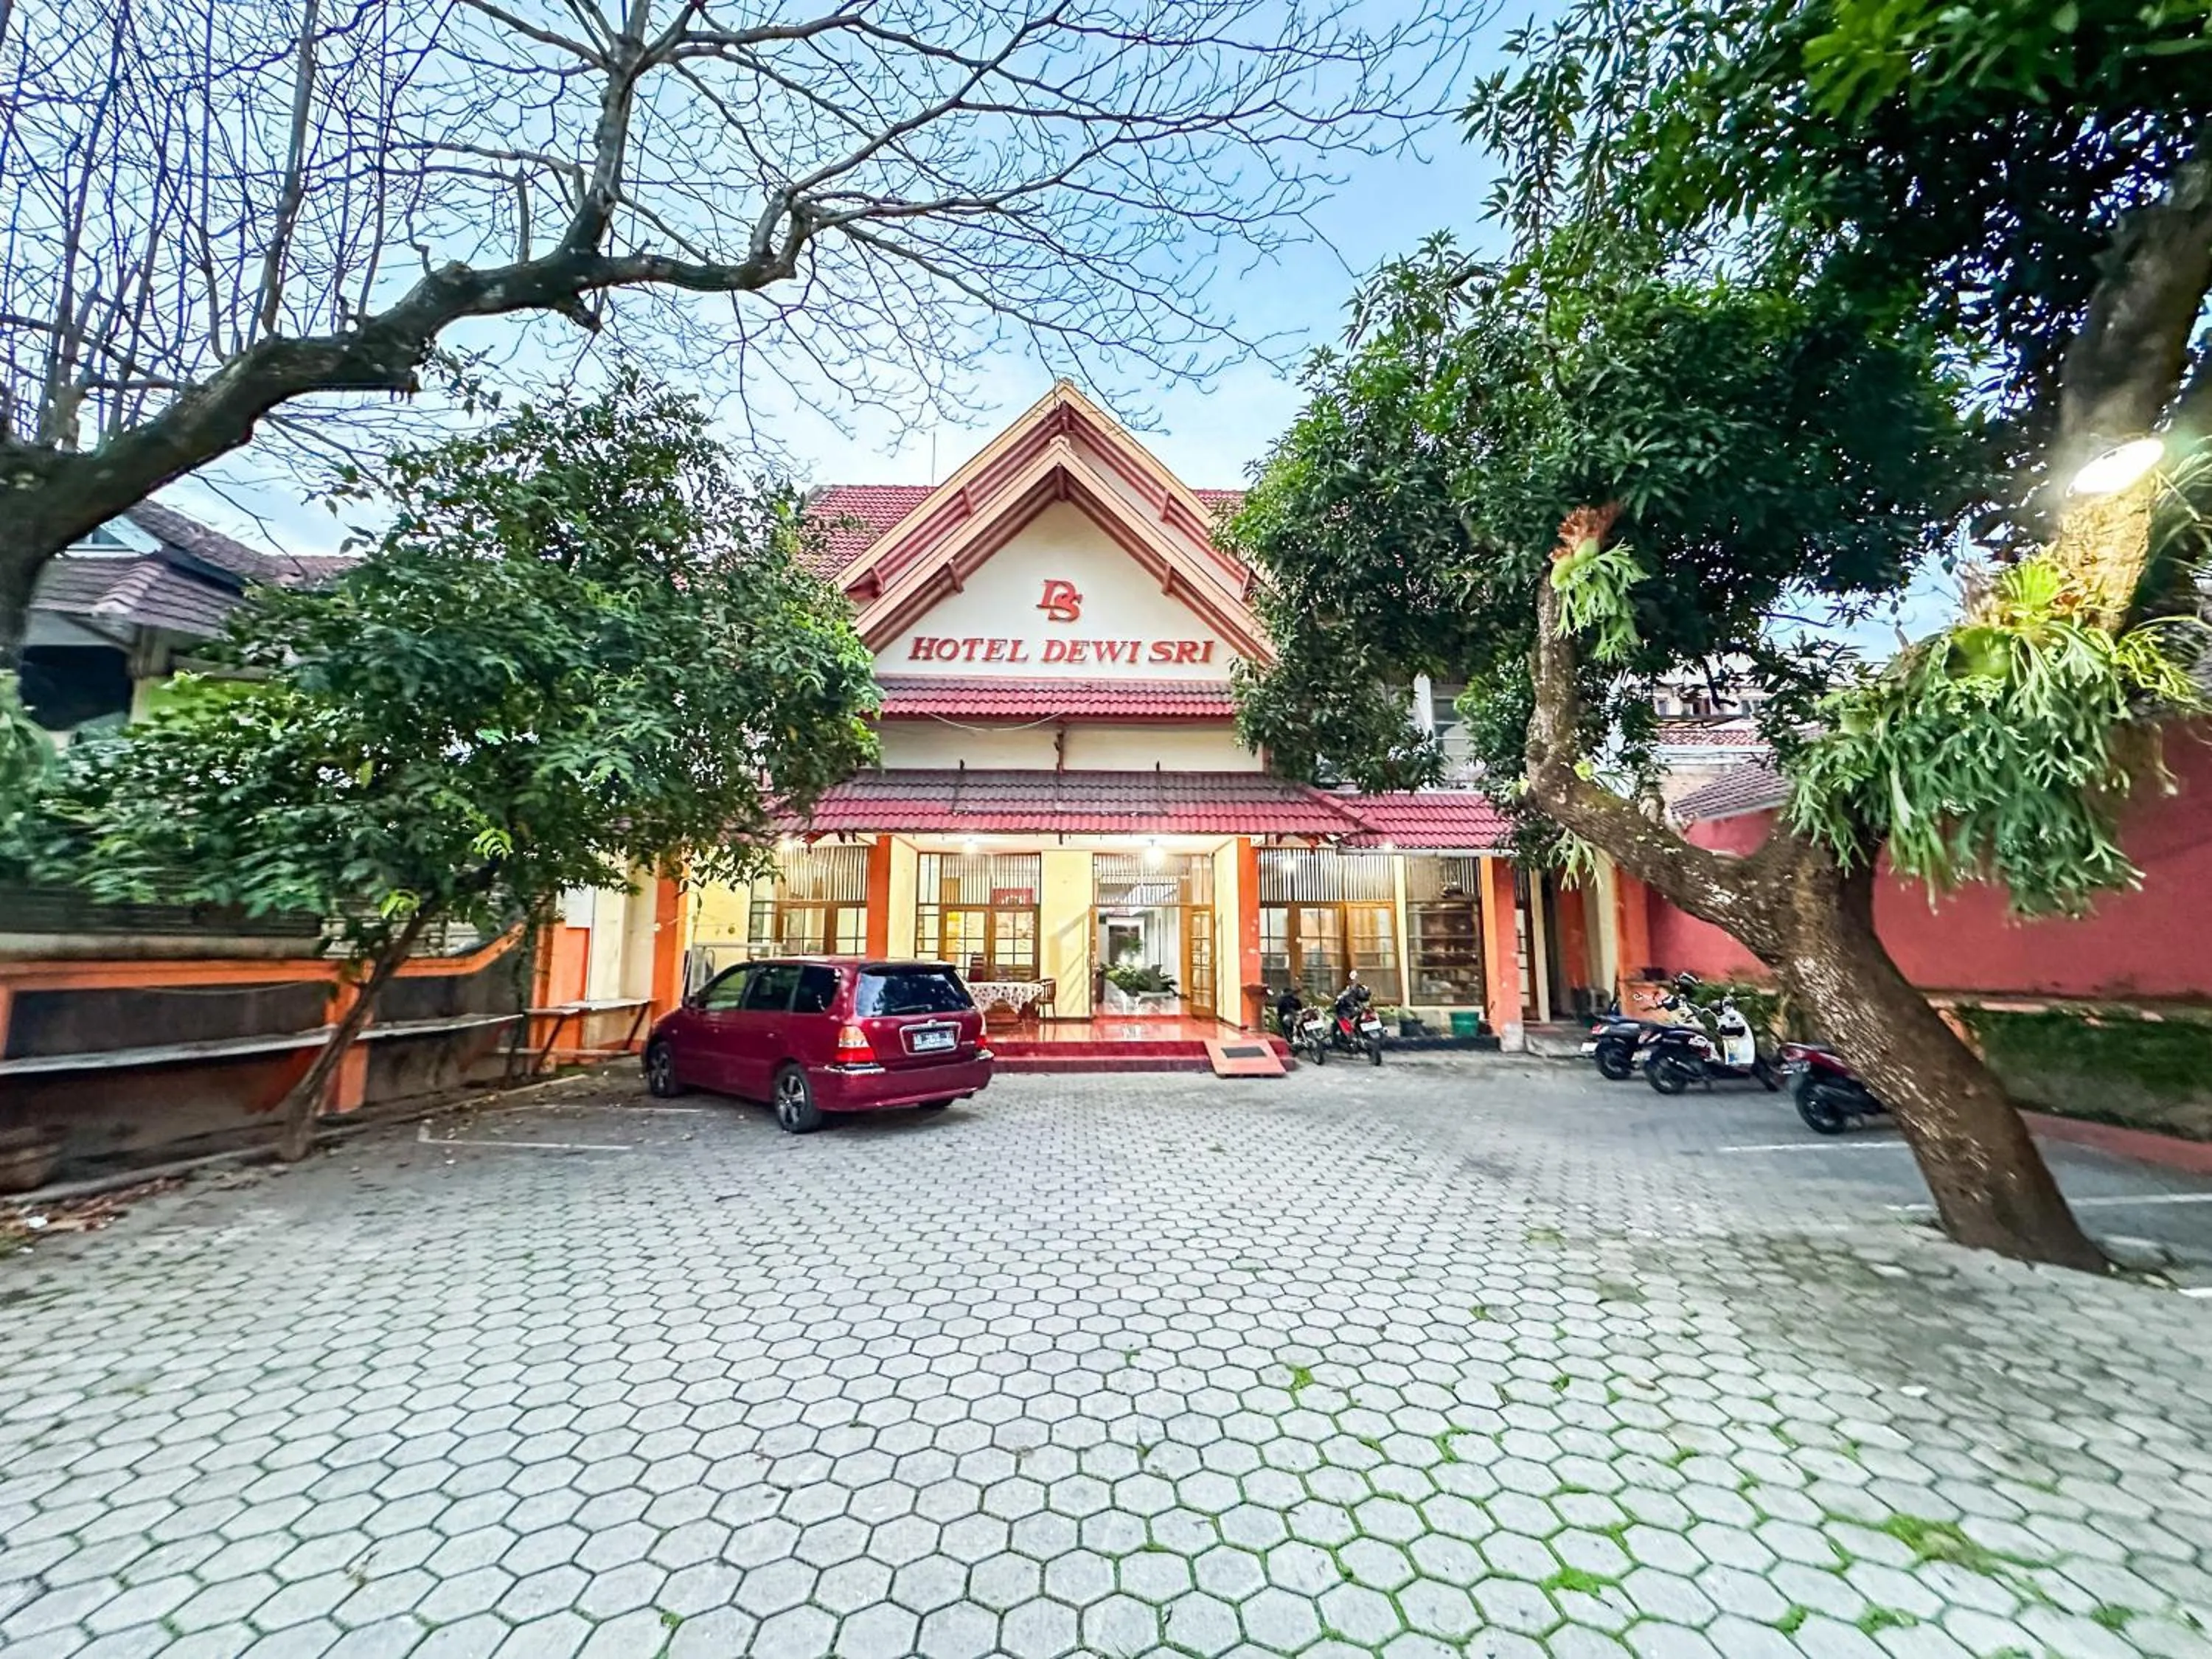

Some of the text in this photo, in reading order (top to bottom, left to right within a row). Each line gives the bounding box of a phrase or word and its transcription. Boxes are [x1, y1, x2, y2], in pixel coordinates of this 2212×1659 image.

[908, 637, 1214, 664] HOTEL DEWI SRI
